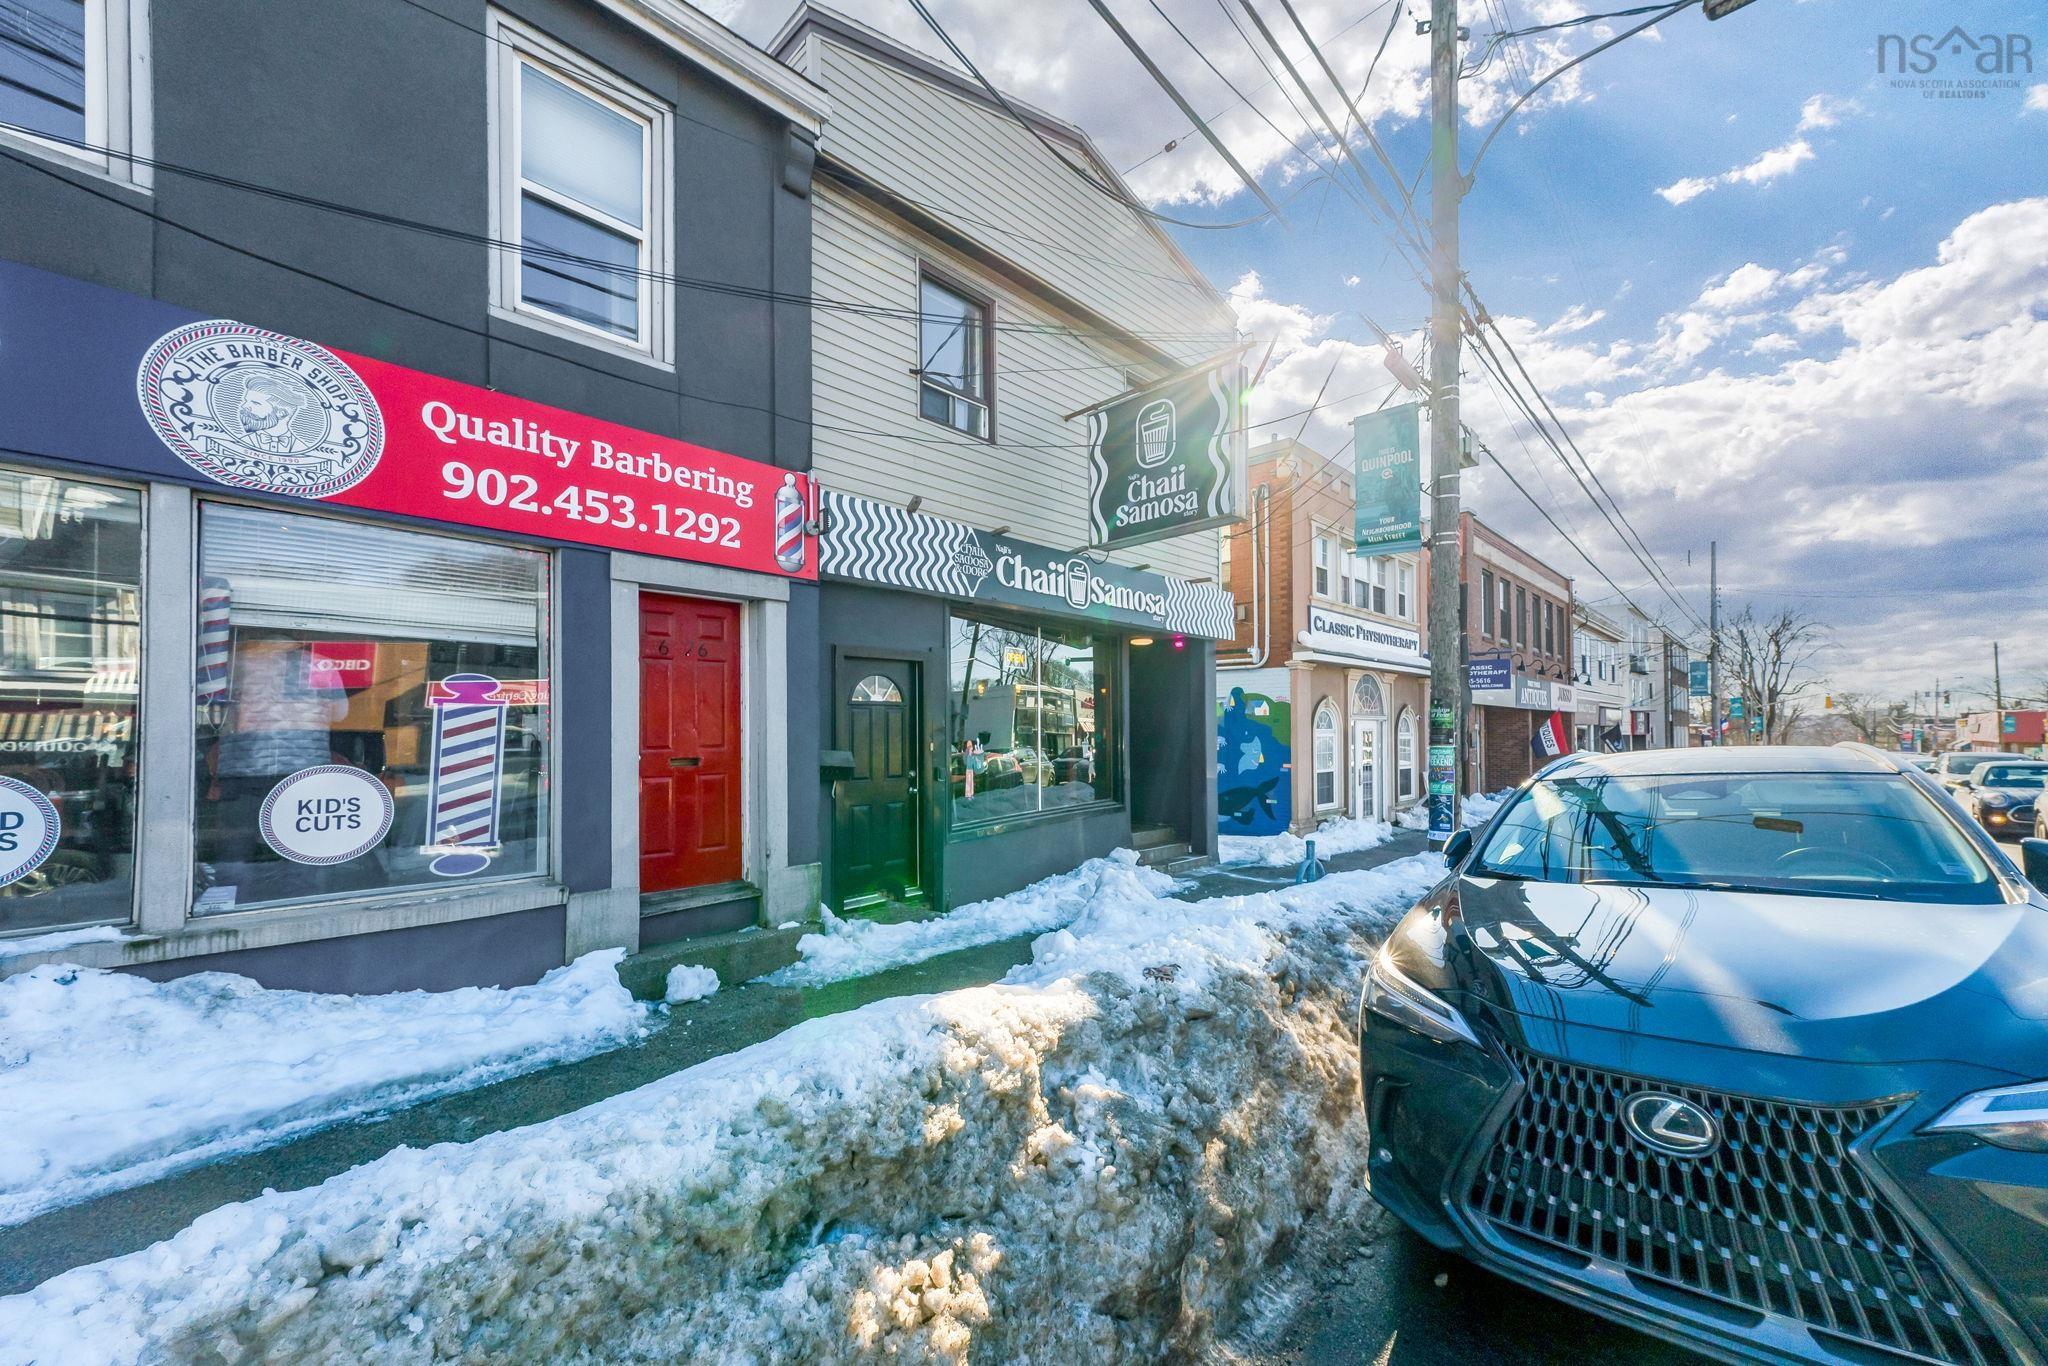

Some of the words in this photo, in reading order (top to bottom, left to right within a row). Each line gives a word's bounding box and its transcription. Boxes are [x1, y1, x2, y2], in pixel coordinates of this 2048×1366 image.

[186, 345, 225, 371] THE
[227, 343, 304, 371] BARBER
[308, 367, 348, 402] SHOP
[243, 447, 273, 462] SINCE
[277, 455, 300, 464] 1990
[421, 400, 580, 468] Quality
[591, 440, 754, 509] Barbering
[1361, 450, 1414, 472] QUINPOOL
[1128, 463, 1186, 503] Chaii
[441, 460, 742, 549] 902.453.1292
[1115, 490, 1199, 527] Samosa
[954, 554, 989, 569] SAMOSA
[995, 554, 1066, 597] Chaii
[1090, 576, 1166, 616] Samosa
[1313, 615, 1355, 638] CLASSIC
[1356, 624, 1418, 651] PHYSIOTHERAPY
[1520, 688, 1548, 709] ANTIQUES
[295, 814, 362, 833] CUTS
[297, 796, 361, 816] KID'S
